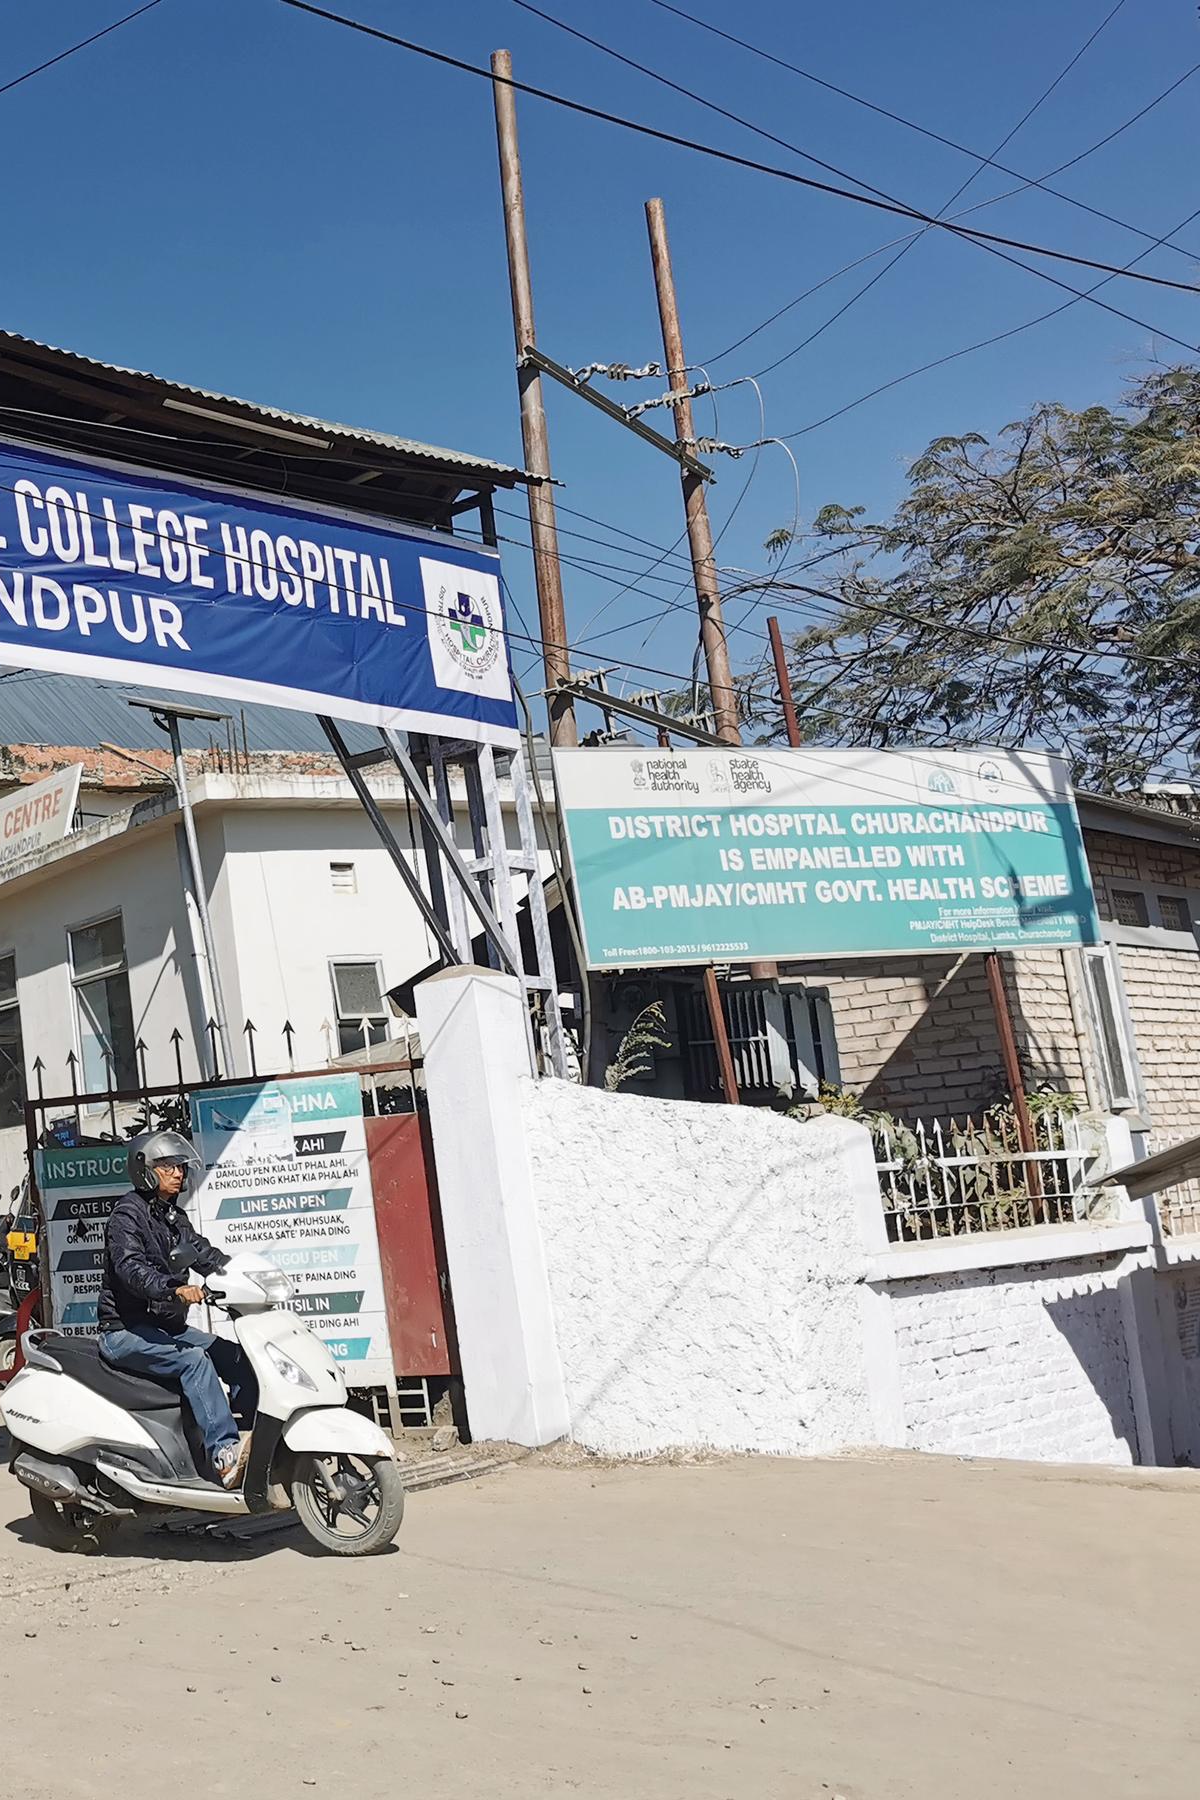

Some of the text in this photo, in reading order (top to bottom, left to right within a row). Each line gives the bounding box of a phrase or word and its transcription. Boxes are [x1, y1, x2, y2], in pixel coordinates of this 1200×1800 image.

[13, 479, 216, 588] COLLEGE
[220, 522, 406, 627] HOSPITAL
[646, 758, 687, 771] national
[729, 758, 759, 770] state
[649, 769, 680, 780] health
[730, 768, 764, 781] health
[651, 779, 700, 793] authority
[733, 779, 772, 793] agency
[3, 787, 64, 839] CENTRE
[608, 811, 1049, 839] DISTRICT HOSPITAL CHURACHANDPUR
[720, 844, 965, 872] IS EMPANELLED WITH
[612, 874, 1070, 911] AB-PMJAY/CMHT GOVT. HEALTH SCHEME
[938, 907, 951, 916] For
[602, 948, 617, 957] Toll
[301, 1137, 325, 1152] AHI
[253, 1166, 270, 1175] PEN
[272, 1164, 286, 1173] KIA
[287, 1163, 302, 1172] LUT
[305, 1160, 328, 1170] PHAL
[207, 1168, 359, 1190] A ENKOLTU DING KHAT KIA PHAL AHI
[70, 1201, 112, 1216] GATE IS
[240, 1194, 326, 1213] LINE SAN PEN
[66, 1235, 79, 1245] OR
[224, 1234, 244, 1244] NAK
[245, 1231, 275, 1243] HAKSA
[300, 1228, 327, 1238] PAINA
[328, 1225, 350, 1235] DING
[312, 1250, 338, 1263] PEN
[62, 1275, 74, 1284] TO
[74, 1274, 85, 1284] BE
[305, 1272, 333, 1283] PAINA
[333, 1270, 357, 1280] DING
[316, 1297, 330, 1311] IN
[320, 1318, 342, 1328] DING
[342, 1317, 360, 1327] AHI
[63, 1327, 74, 1337] TO
[75, 1326, 85, 1336] BE
